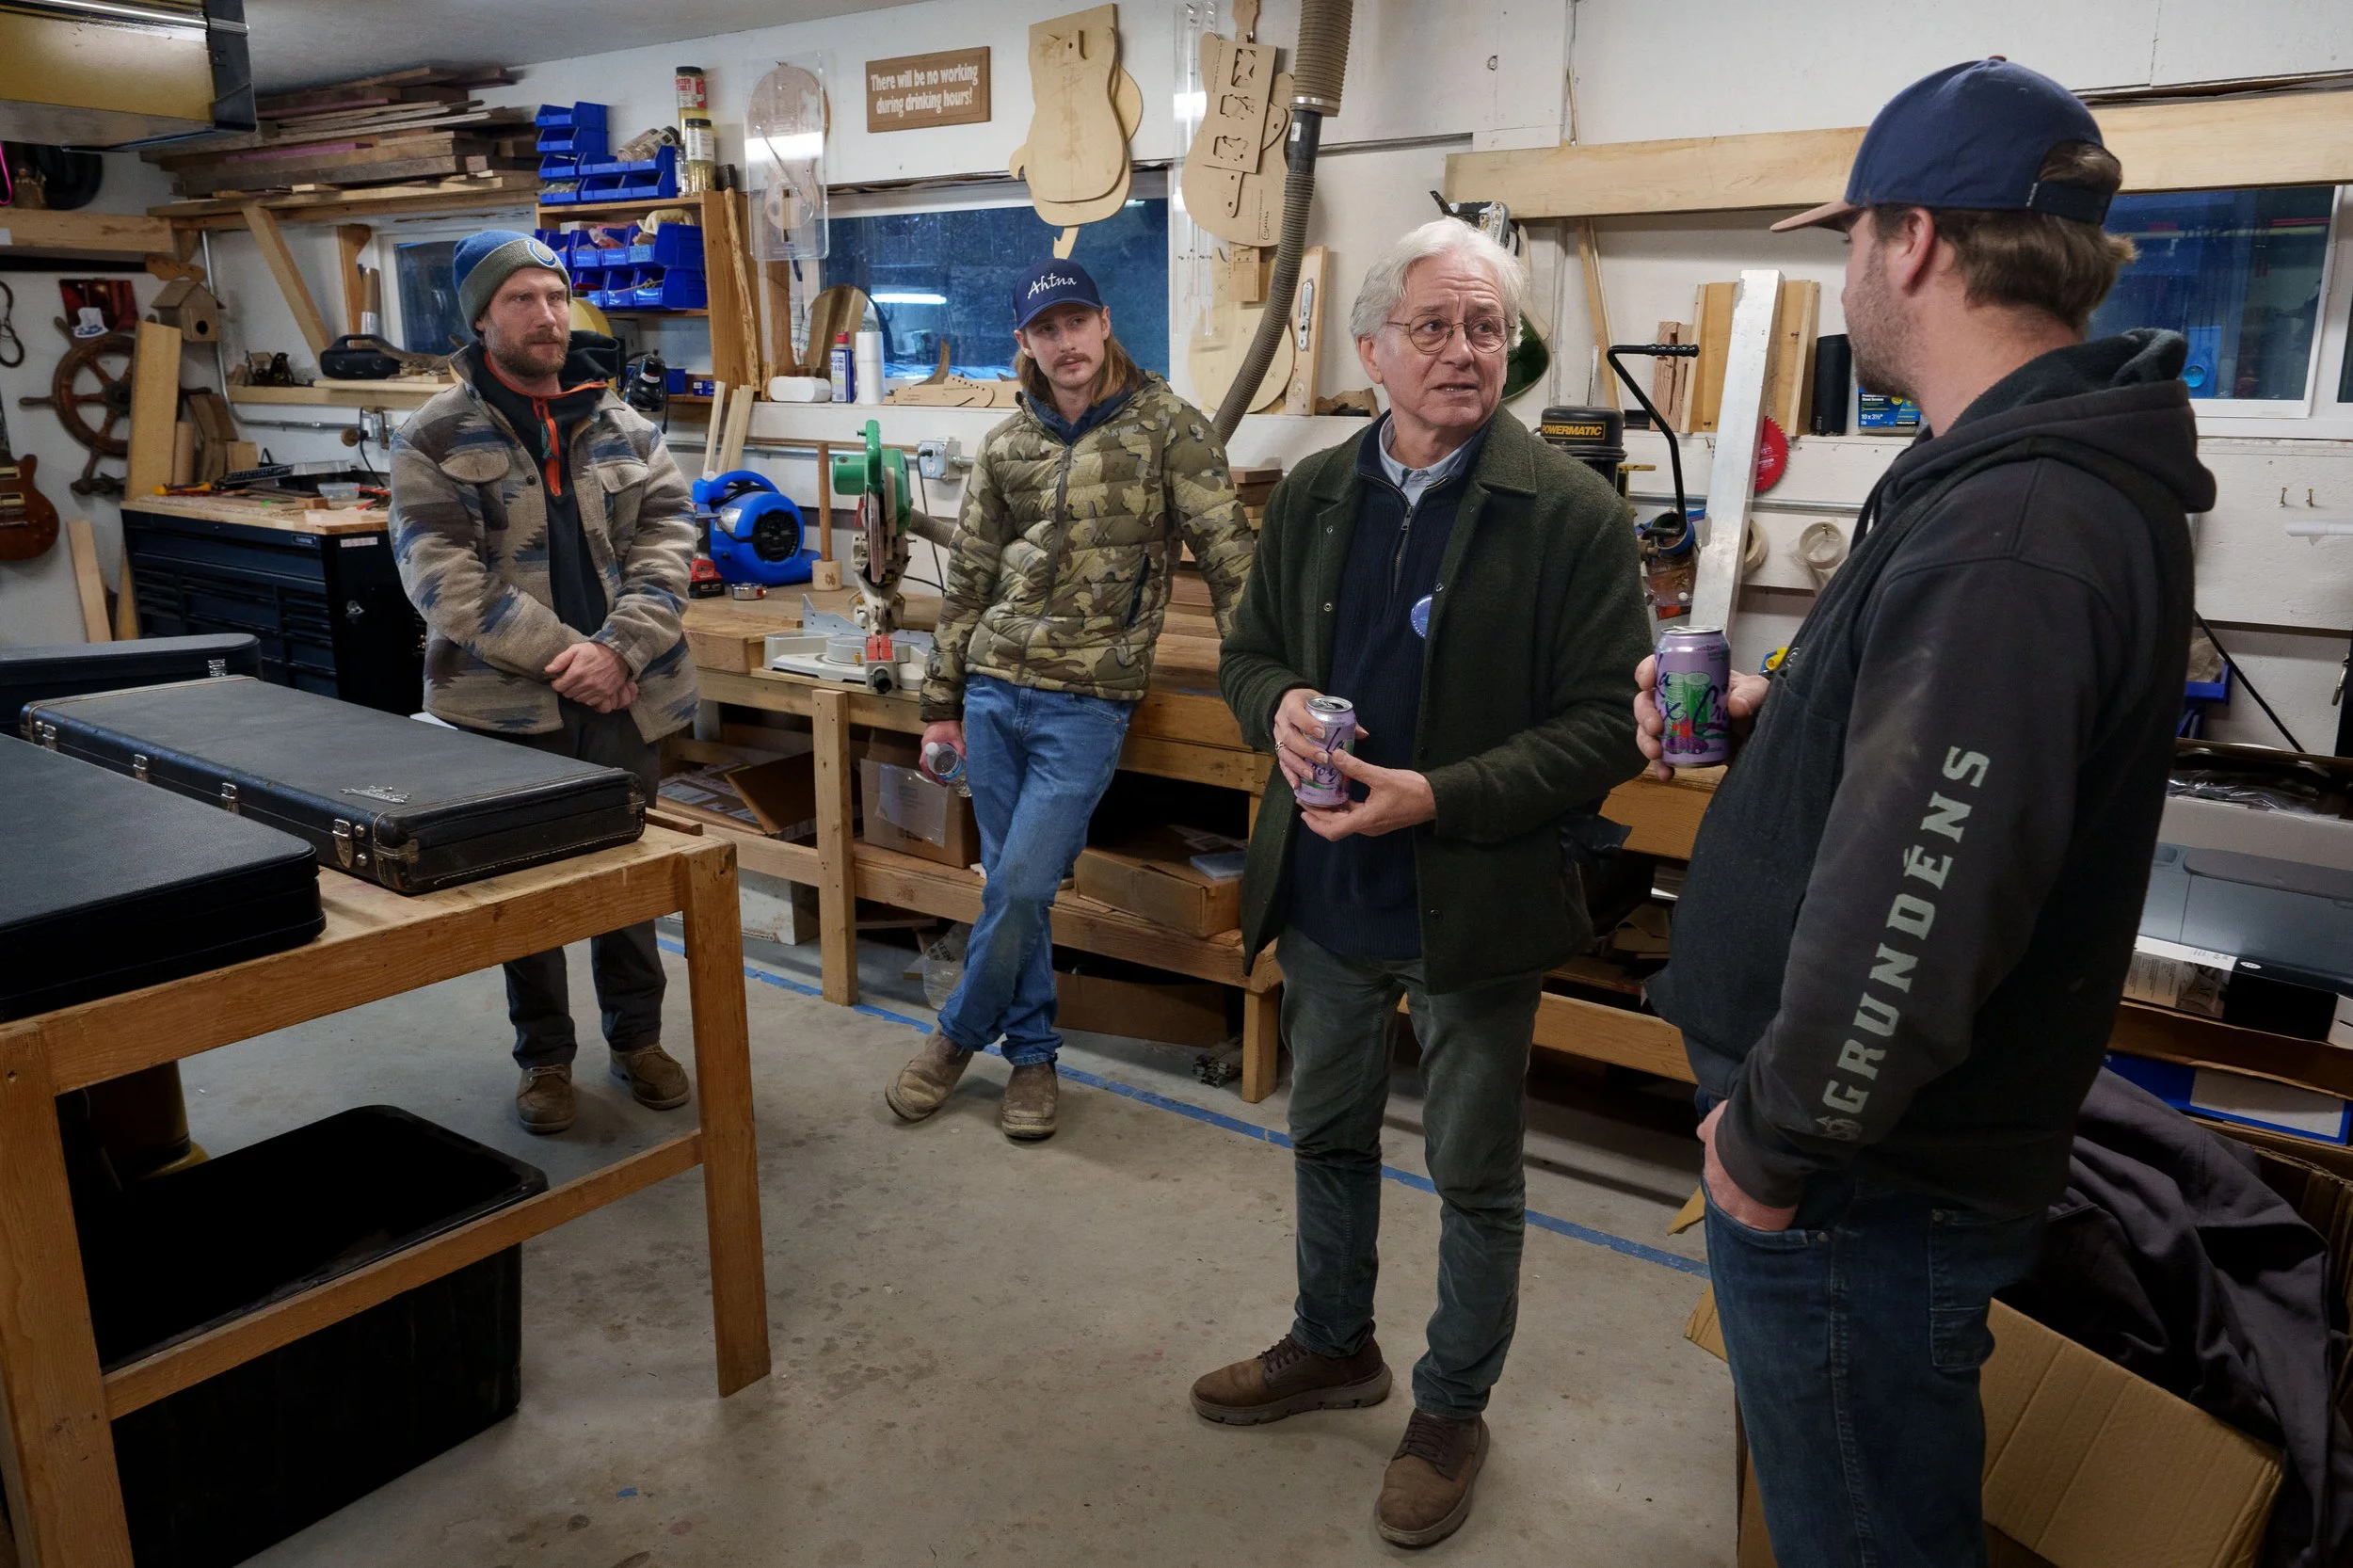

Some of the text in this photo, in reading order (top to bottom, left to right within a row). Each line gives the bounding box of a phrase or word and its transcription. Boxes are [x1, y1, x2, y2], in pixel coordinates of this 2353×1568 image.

[871, 63, 978, 91] There will be no working
[876, 87, 973, 117] during drinking hours!
[1027, 272, 1077, 299] Ahtna
[1542, 424, 1602, 436] POWERMATIC
[1821, 745, 1992, 1115] GRUNDÉNS
